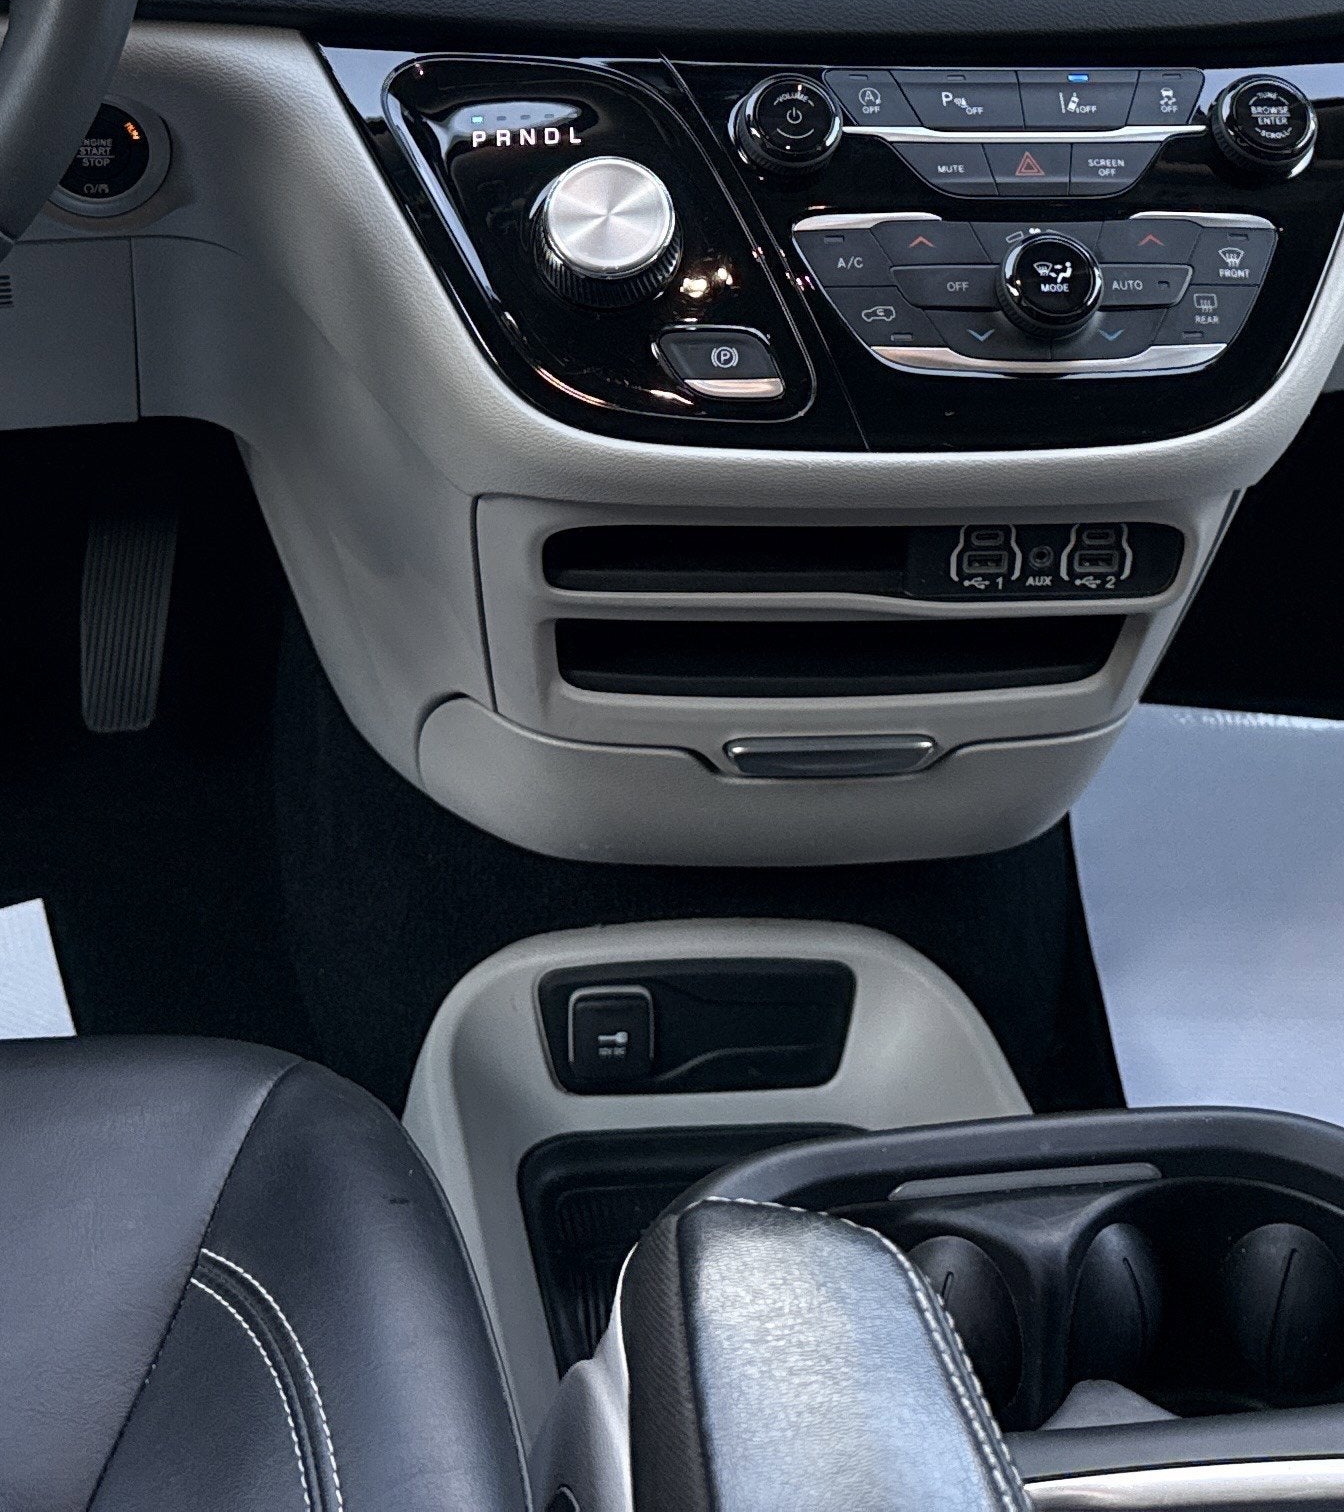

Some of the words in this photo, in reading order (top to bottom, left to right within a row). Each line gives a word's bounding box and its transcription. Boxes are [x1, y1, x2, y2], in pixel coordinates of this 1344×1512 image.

[862, 105, 881, 115] OFF
[966, 106, 984, 115] OFF
[1079, 104, 1098, 114] OFF
[1160, 104, 1179, 114] OFF
[1250, 105, 1289, 114] BROWSE
[1257, 116, 1288, 125] ENTER
[81, 138, 113, 146] NGINE
[79, 146, 112, 156] START
[82, 157, 111, 167] STOP
[1087, 158, 1125, 167] SCREEN
[937, 164, 965, 173] MUTE
[1098, 168, 1116, 177] OFF
[837, 255, 864, 269] A/C
[1218, 268, 1250, 279] FRONT
[946, 281, 970, 292] OFF
[1040, 283, 1070, 293] MODE
[1112, 279, 1144, 291] AUTO
[1194, 315, 1220, 325] REAR
[995, 577, 1004, 590] 1
[1025, 575, 1053, 587] AUX
[1104, 576, 1118, 589] 2
